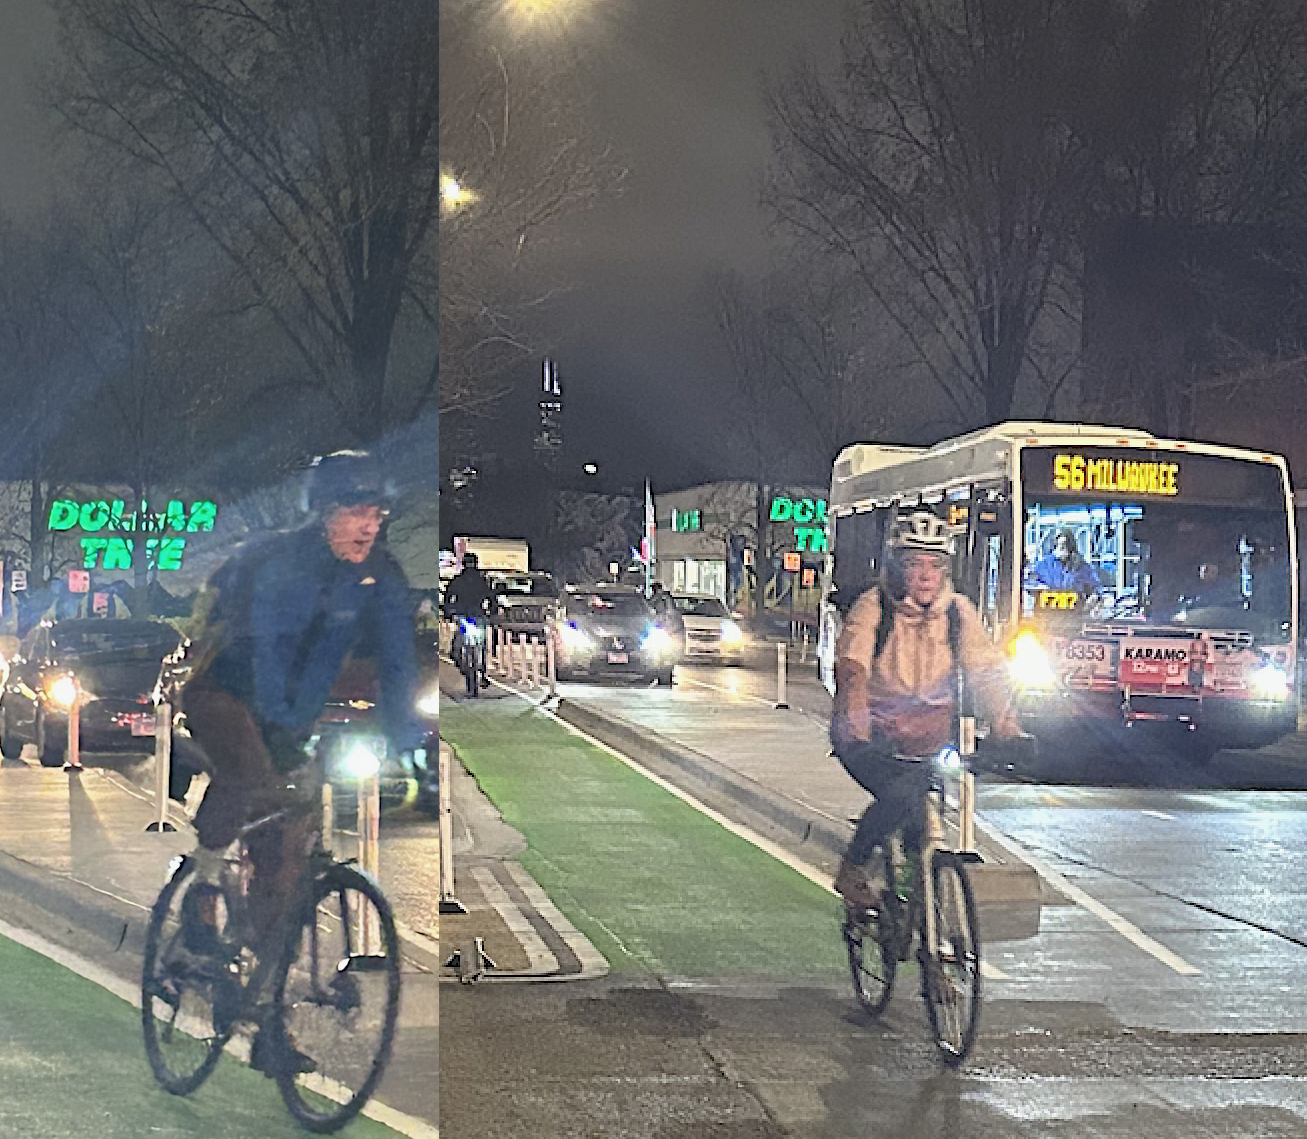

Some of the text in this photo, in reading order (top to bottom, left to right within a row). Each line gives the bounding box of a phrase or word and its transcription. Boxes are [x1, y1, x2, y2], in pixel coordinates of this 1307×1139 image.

[1054, 454, 1179, 495] 56 MILWAUKEE
[1125, 648, 1187, 660] KARAMO
